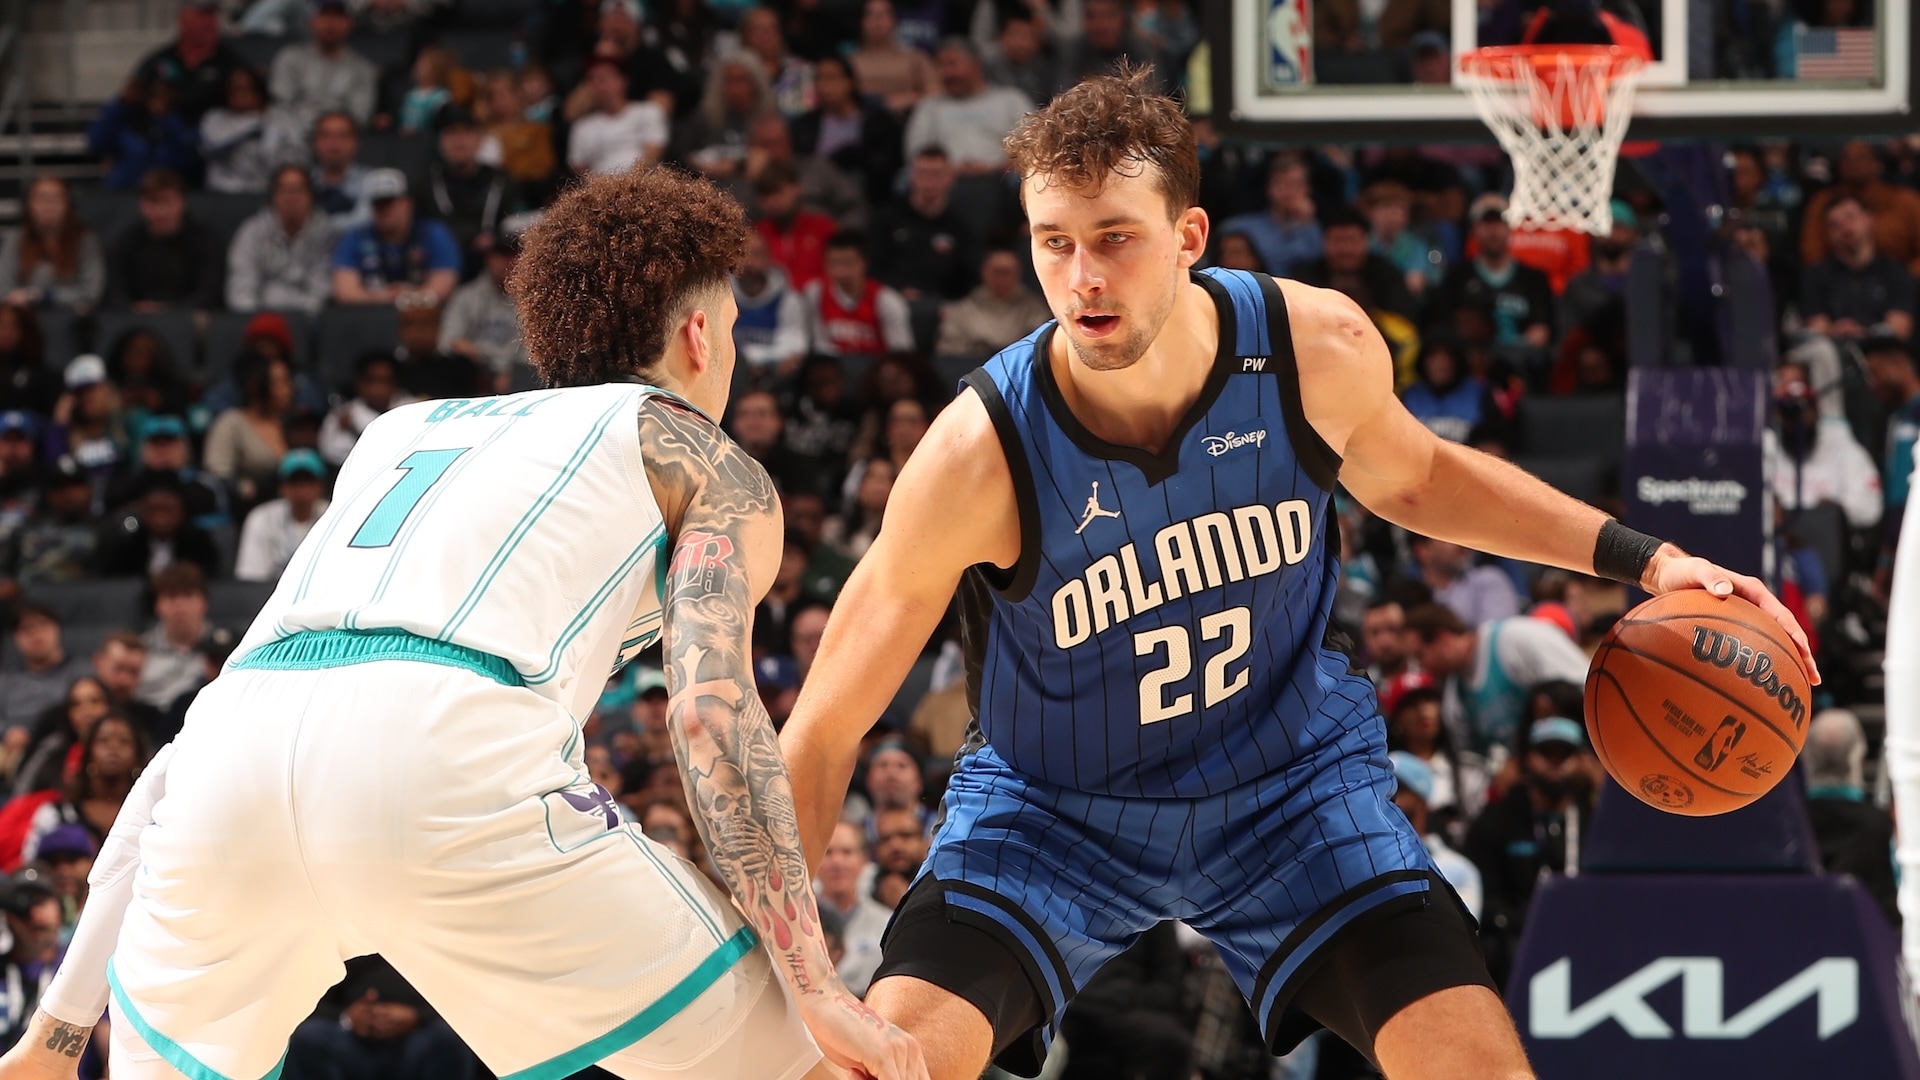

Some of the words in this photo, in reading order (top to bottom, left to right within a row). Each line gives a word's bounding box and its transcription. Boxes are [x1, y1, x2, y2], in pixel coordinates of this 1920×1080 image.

[424, 398, 545, 423] BALL
[1242, 358, 1266, 372] PW
[347, 447, 473, 548] 1
[1051, 498, 1312, 649] ORLANDO
[1134, 606, 1252, 725] 22
[1691, 625, 1805, 731] Wilson
[1530, 957, 1858, 1039] KIA
